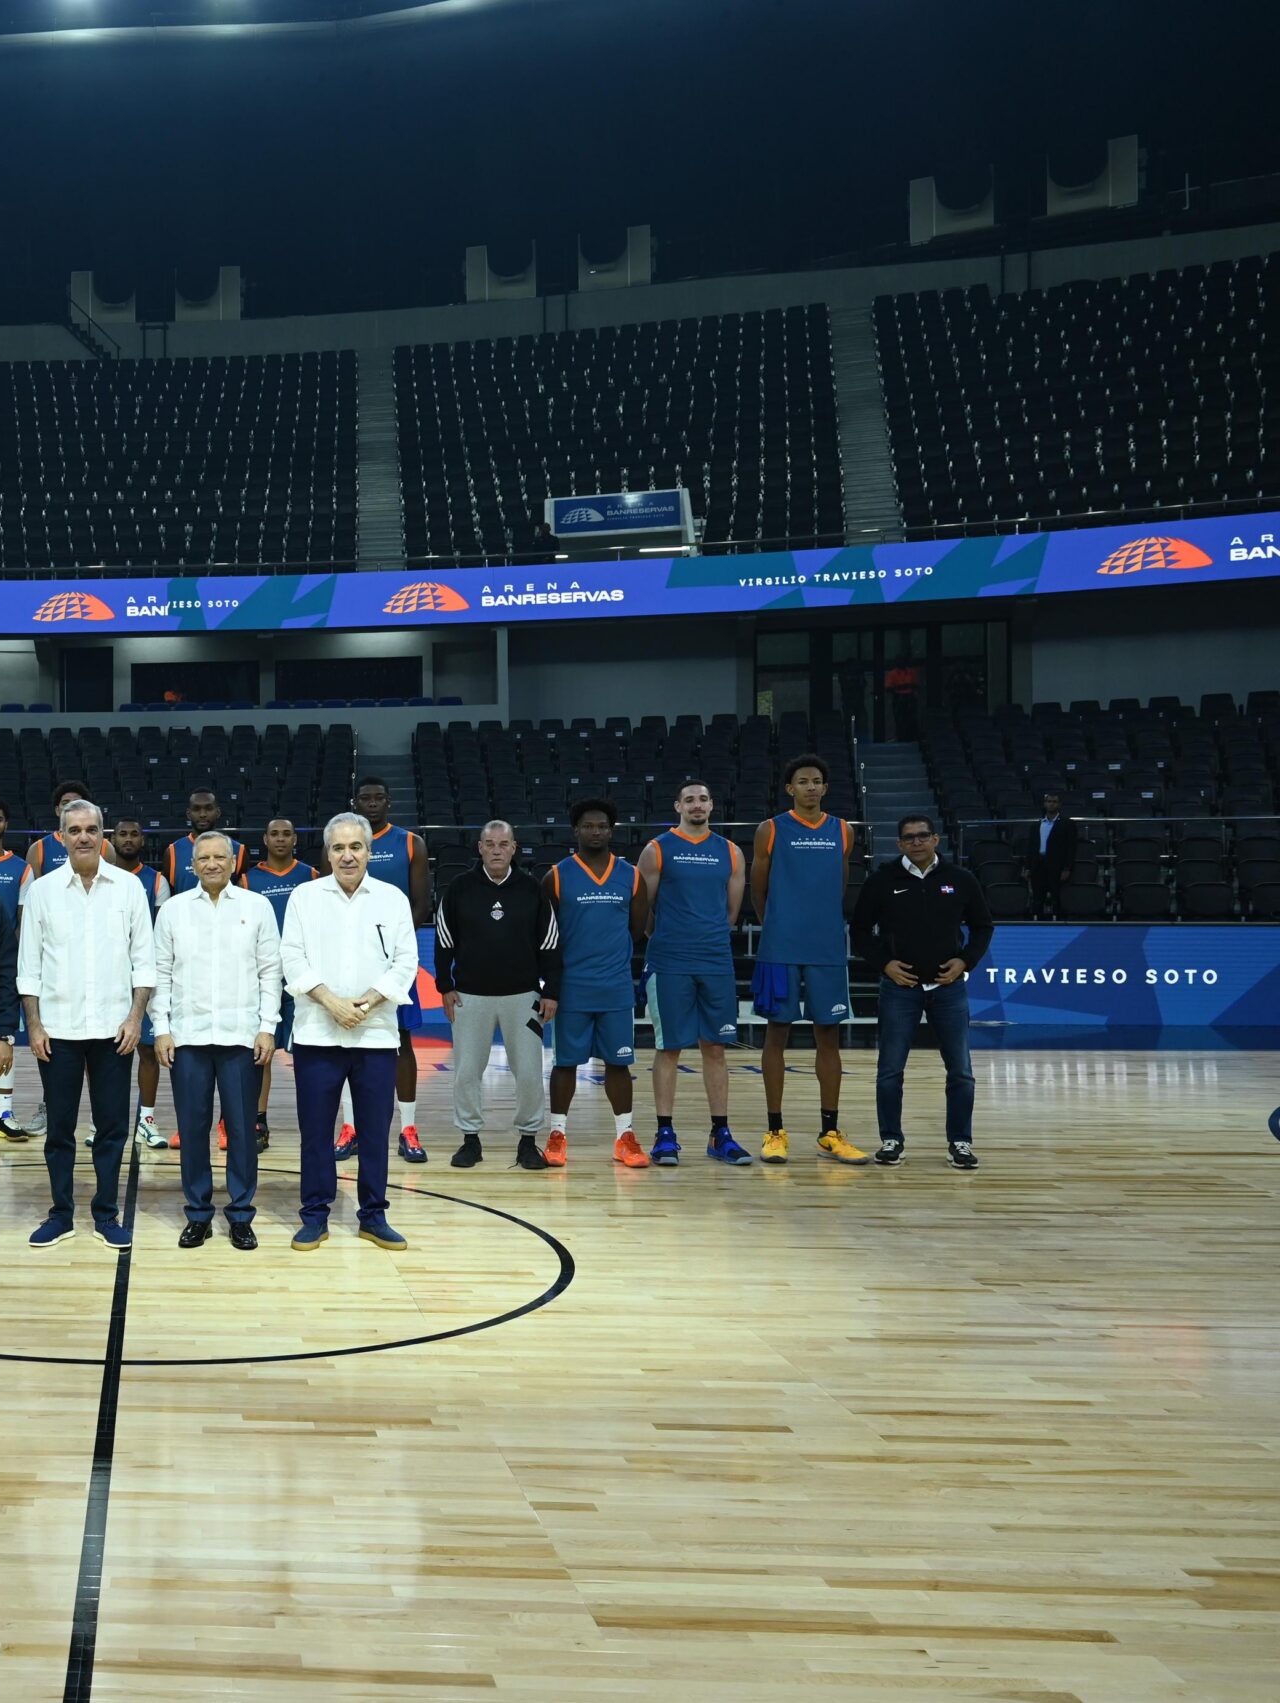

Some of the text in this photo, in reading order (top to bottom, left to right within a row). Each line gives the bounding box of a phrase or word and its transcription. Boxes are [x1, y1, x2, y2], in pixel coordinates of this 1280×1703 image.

[606, 505, 675, 516] BANRESERVAS
[739, 566, 933, 587] VIRGILIO TRAVIESO SOTO
[481, 581, 580, 594] ARENA
[207, 599, 239, 608] SOTO
[481, 589, 625, 607] BANRESERVAS
[985, 968, 1127, 985] TRAVIESO
[1145, 968, 1218, 985] SOTO
